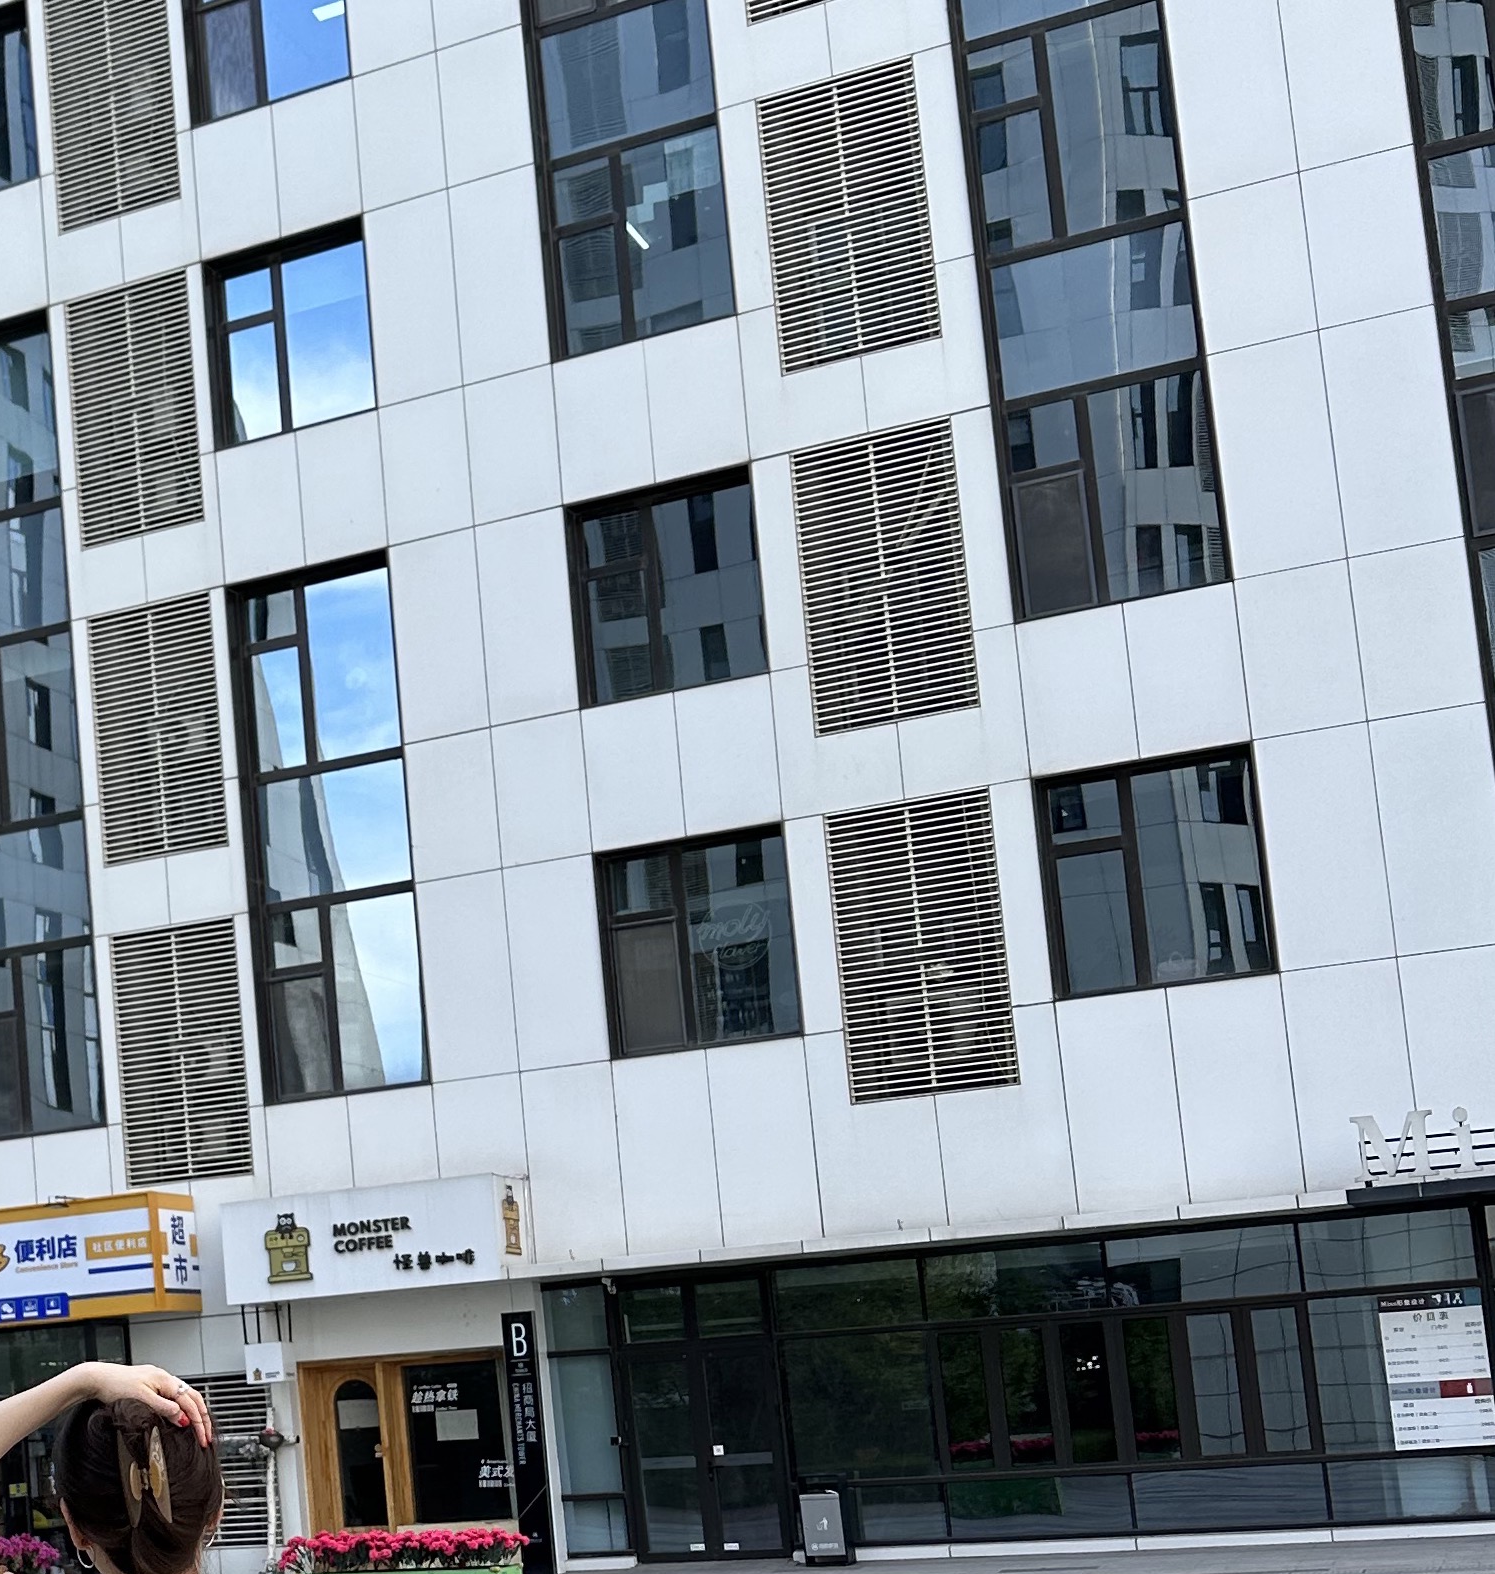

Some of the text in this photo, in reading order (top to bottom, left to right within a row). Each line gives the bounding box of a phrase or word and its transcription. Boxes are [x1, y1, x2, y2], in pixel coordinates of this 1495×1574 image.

[332, 1216, 412, 1237] MONSTER
[14, 1234, 77, 1264] 便利店
[92, 1236, 147, 1253] 社区便利店
[170, 1214, 188, 1285] 超市
[333, 1234, 394, 1254] COFFEE
[393, 1248, 476, 1271] 怪兽咖啡
[1413, 1311, 1449, 1322] 价目表
[511, 1323, 527, 1356] B
[522, 1382, 538, 1443] 招商局大厦
